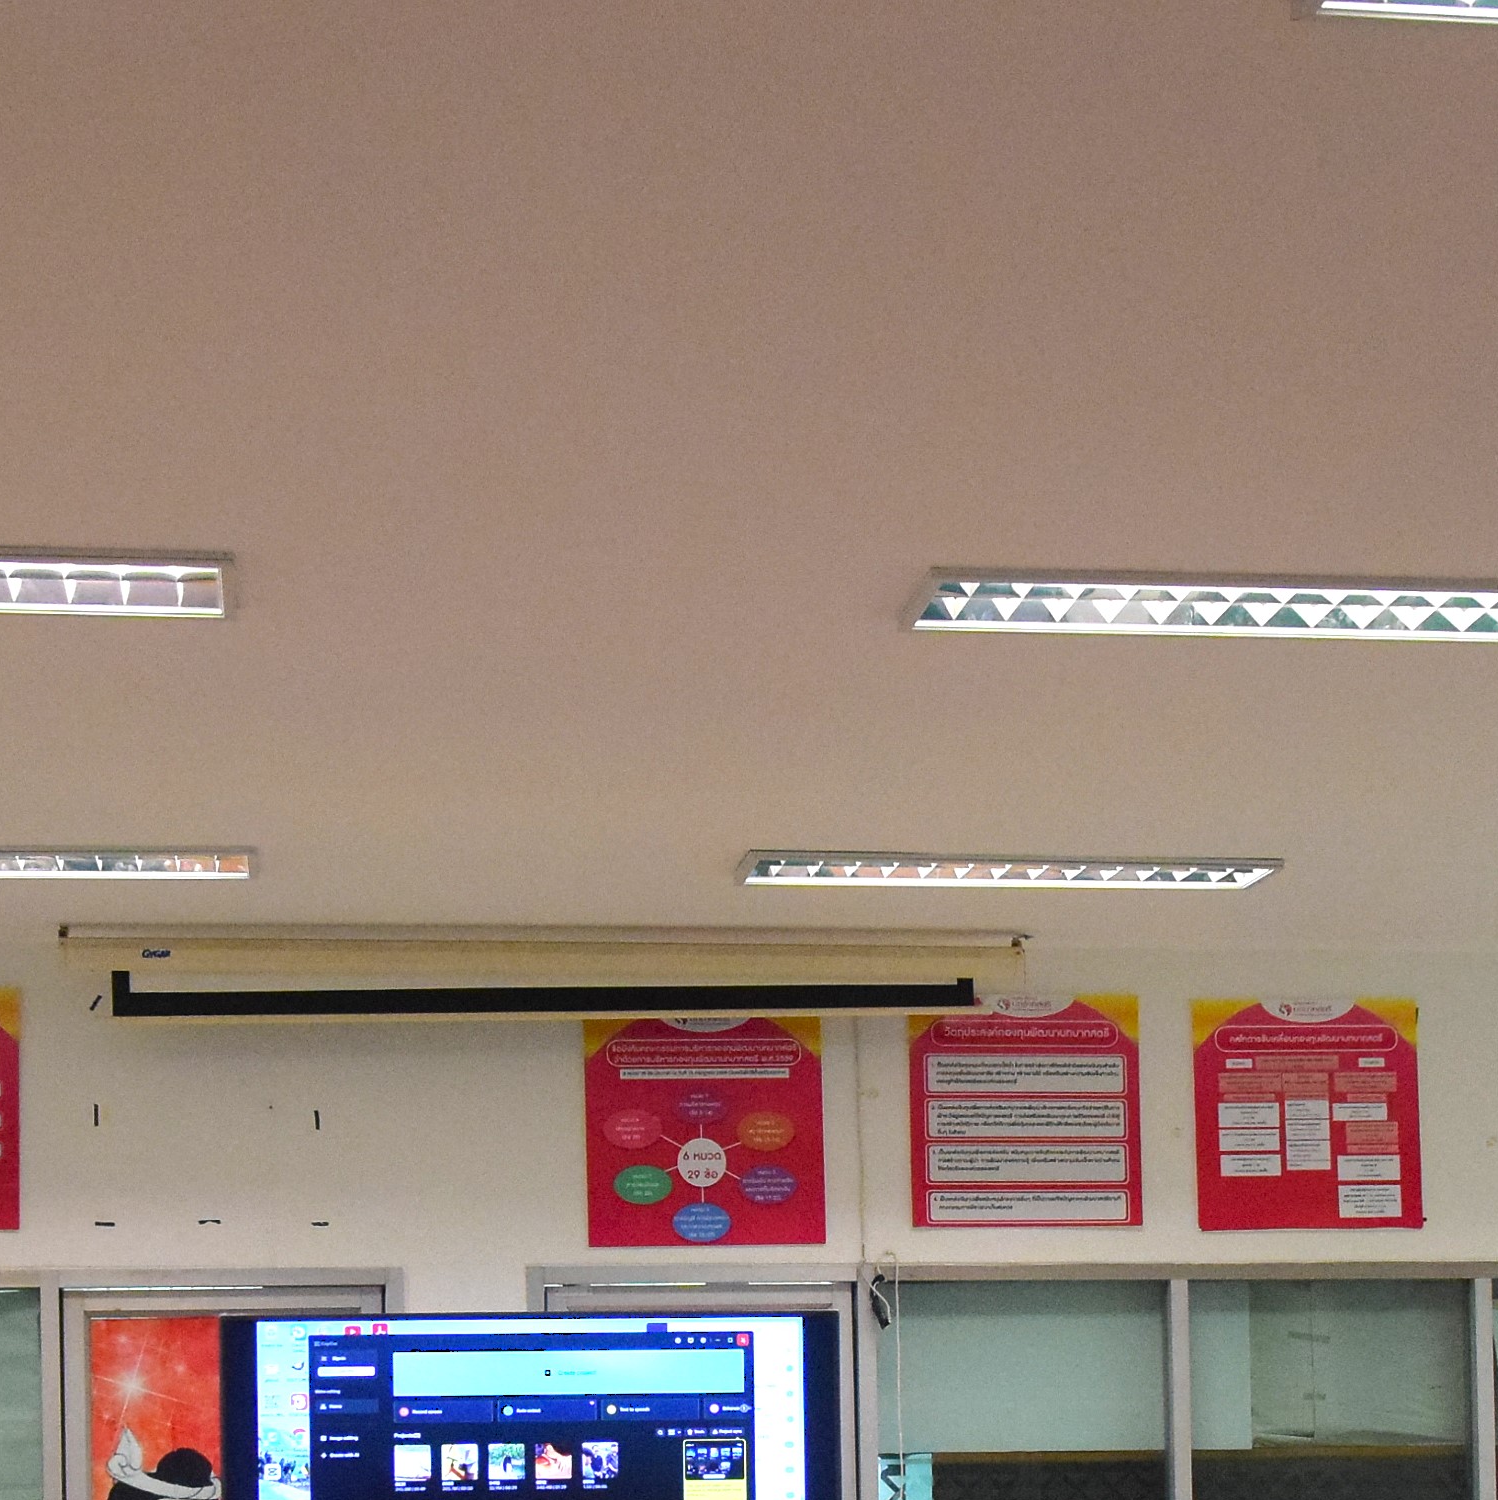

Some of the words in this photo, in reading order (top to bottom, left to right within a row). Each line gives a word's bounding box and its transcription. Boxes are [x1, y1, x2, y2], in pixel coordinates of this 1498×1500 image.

[683, 1151, 690, 1161] 6
[693, 1152, 722, 1161] หมวด
[687, 1170, 700, 1179] 29
[704, 1167, 719, 1179] ข้อ
